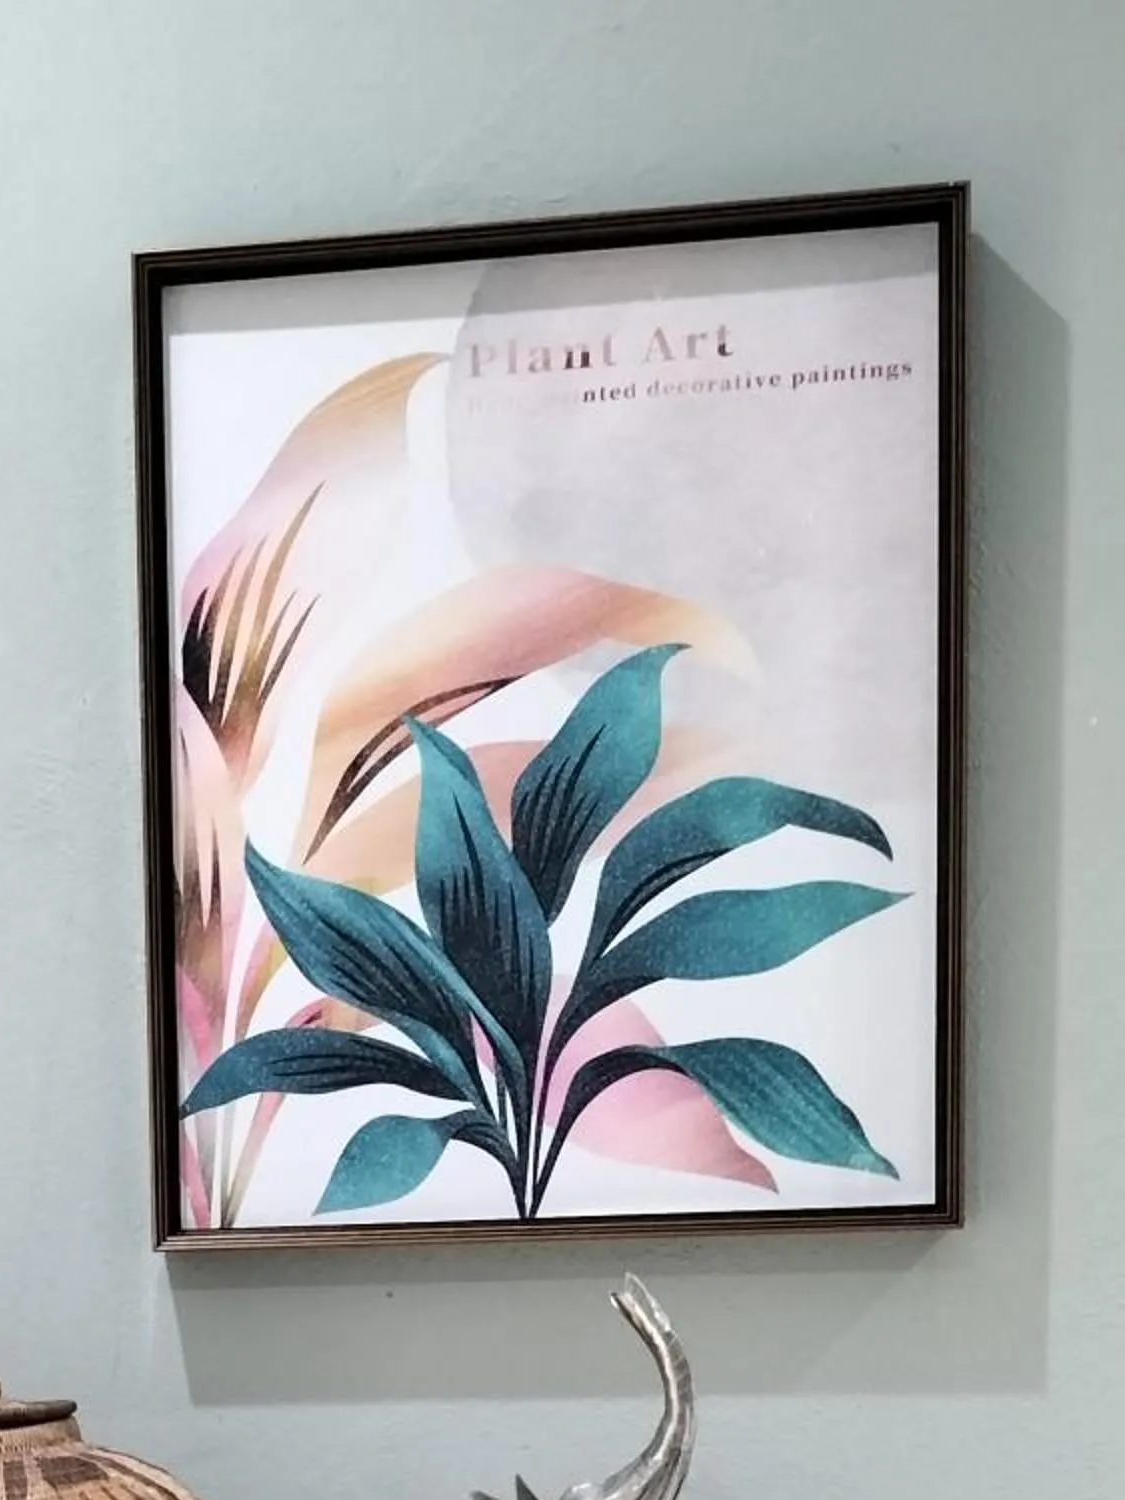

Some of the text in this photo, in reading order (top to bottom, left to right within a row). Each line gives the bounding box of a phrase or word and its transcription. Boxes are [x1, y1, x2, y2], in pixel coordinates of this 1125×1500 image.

[468, 325, 734, 378] Plant Art
[646, 370, 782, 397] decorative
[792, 360, 913, 390] paintings
